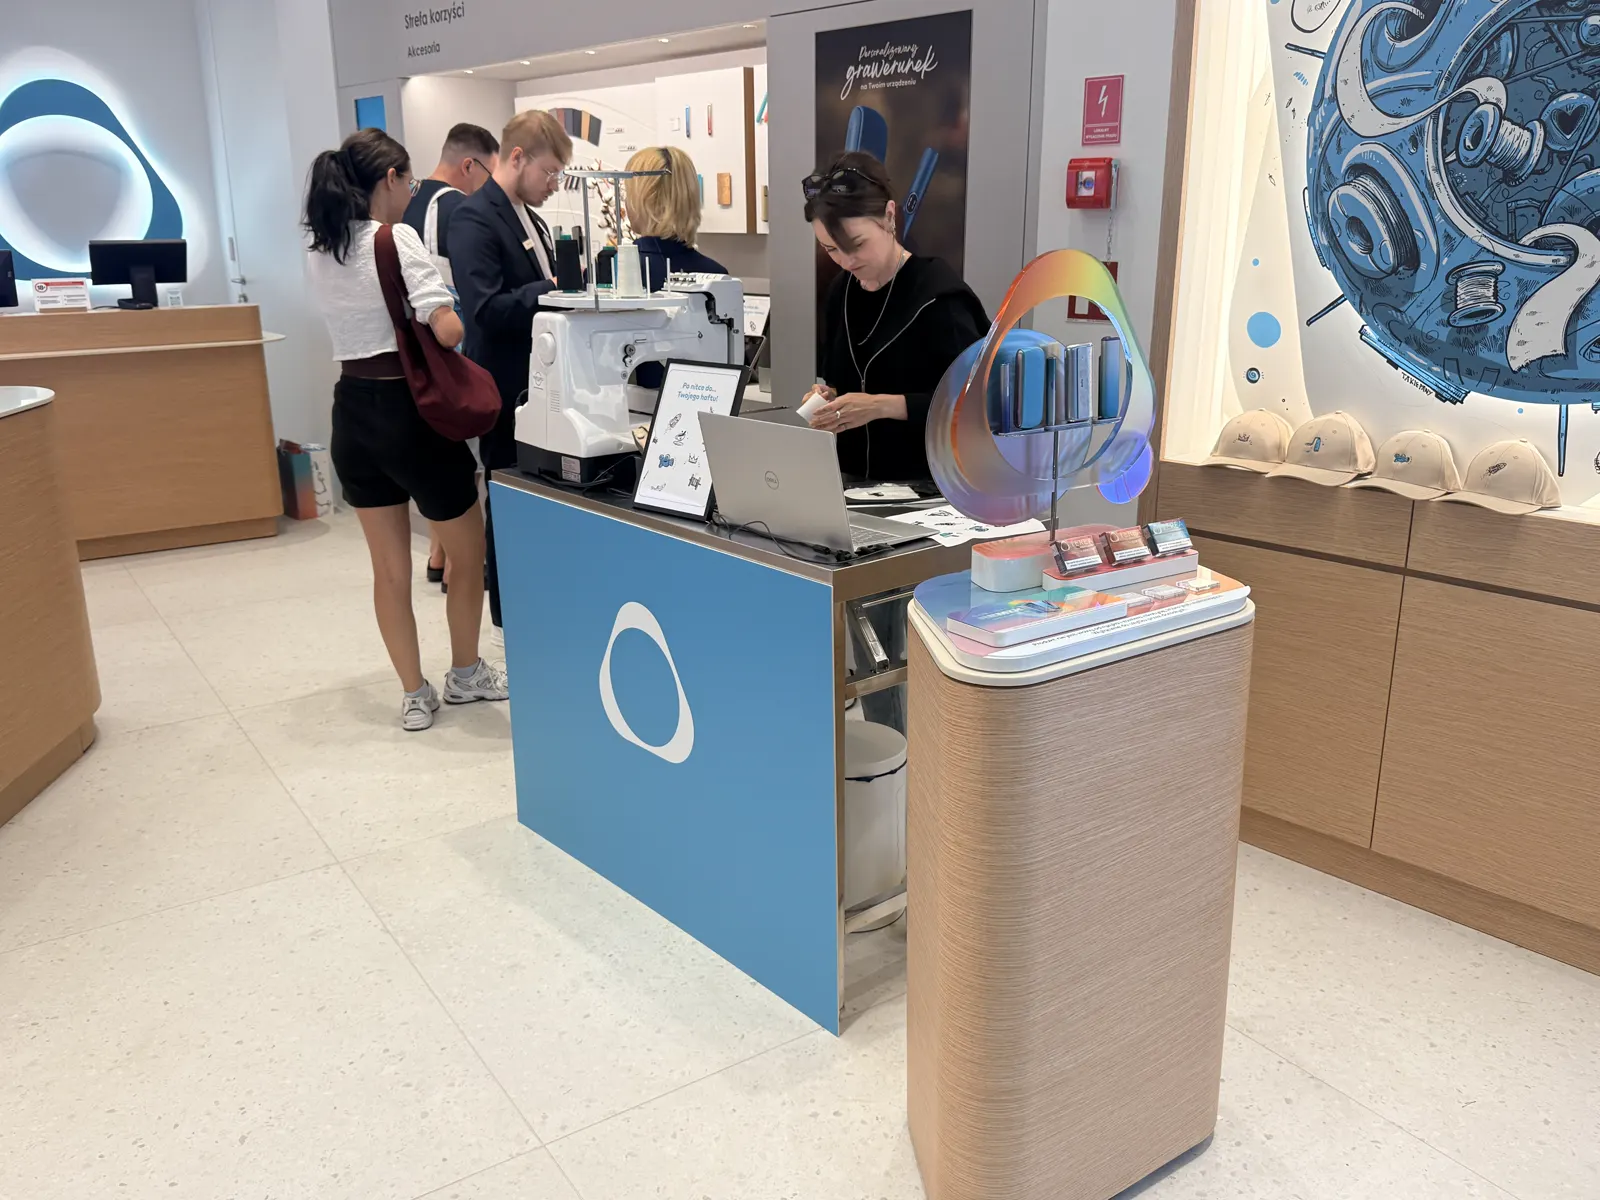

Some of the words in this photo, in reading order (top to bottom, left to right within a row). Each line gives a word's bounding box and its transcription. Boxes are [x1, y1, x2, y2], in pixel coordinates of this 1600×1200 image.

[405, 11, 428, 30] Strefa
[429, 1, 465, 25] korzyści
[407, 41, 441, 58] Akcesoria
[840, 45, 939, 101] grawerunek
[886, 78, 917, 88] urządzeniu
[690, 383, 705, 391] nitce
[677, 391, 700, 402] Twojego
[700, 393, 719, 402] haftu!
